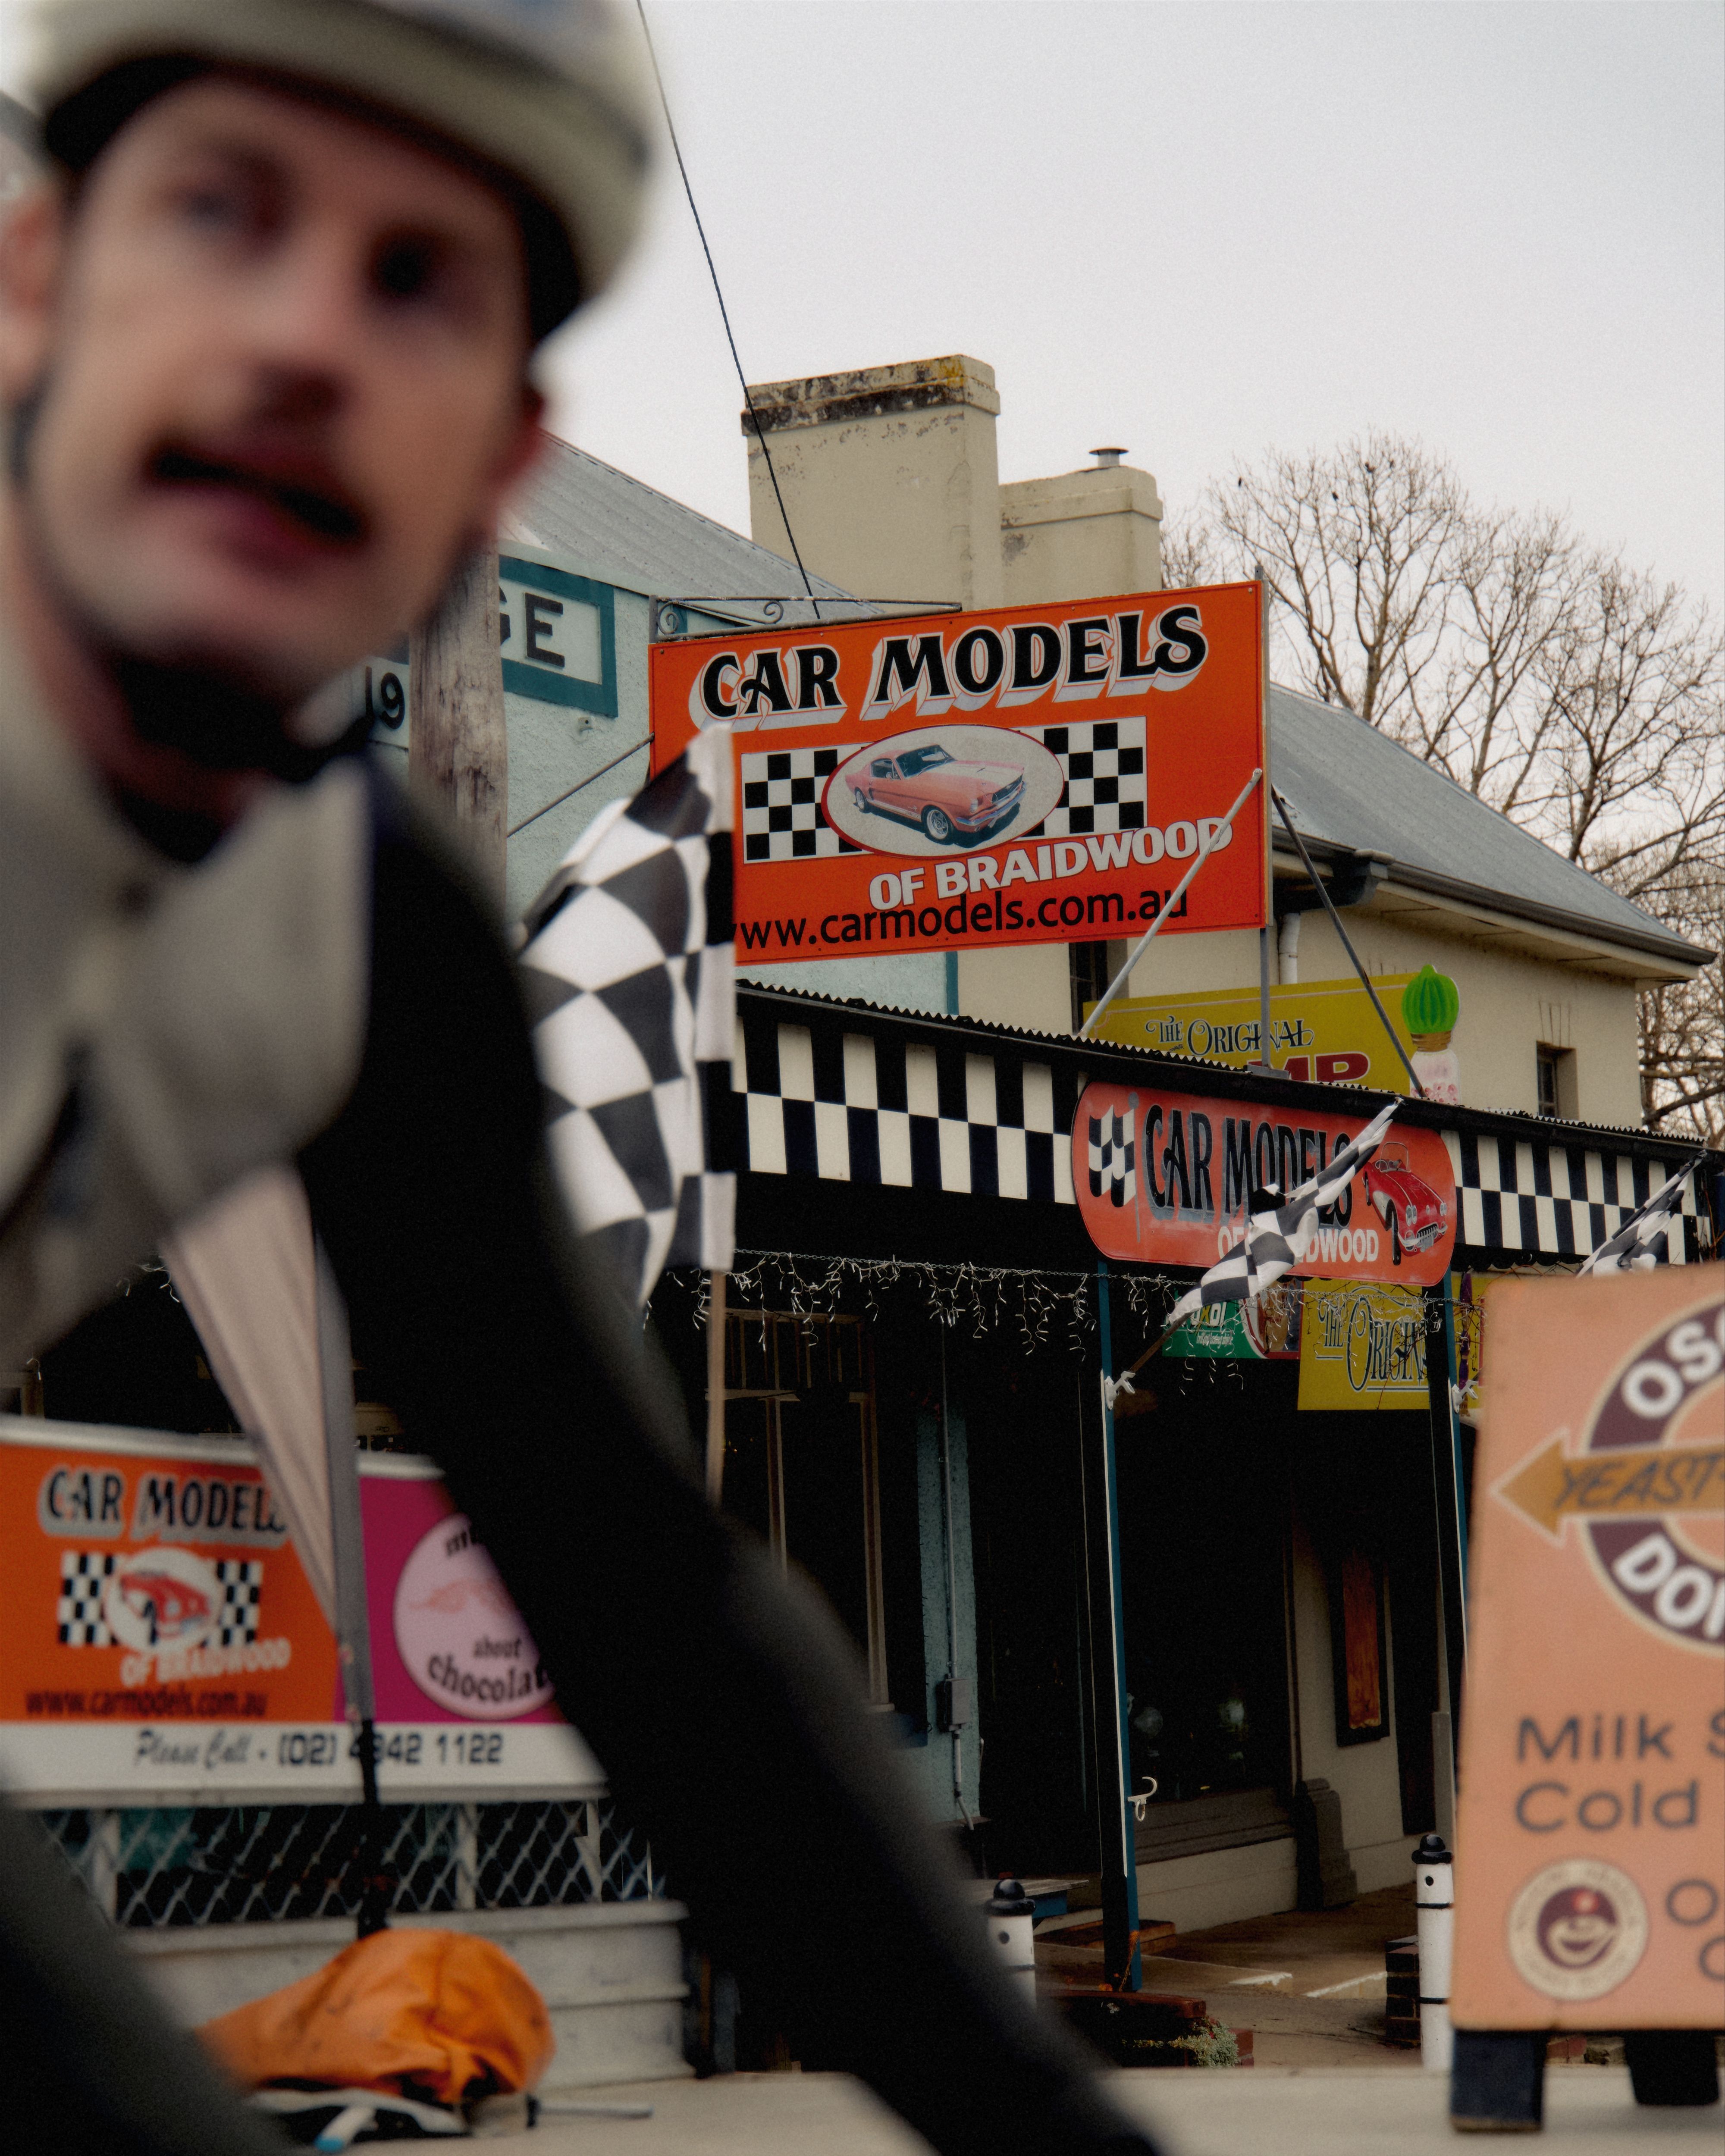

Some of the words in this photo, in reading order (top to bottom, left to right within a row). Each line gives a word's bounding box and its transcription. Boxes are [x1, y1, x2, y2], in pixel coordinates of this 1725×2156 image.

[695, 645, 846, 724] CAR
[862, 605, 1208, 714] MODELS
[869, 867, 925, 910] OF
[935, 817, 1233, 899] BRAIDWOOD
[733, 889, 1188, 949] ww.carmodels.com.au
[1145, 1015, 1184, 1043] THE
[1187, 1019, 1314, 1056] ORIGINAL
[1143, 1104, 1217, 1219] CAR
[1221, 1115, 1352, 1228] MODELS
[1304, 1228, 1379, 1263] DWOOD
[1318, 1299, 1346, 1347] THE
[1347, 1295, 1428, 1391] ORIGIN
[1620, 1307, 1725, 1420] OS
[45, 1467, 124, 1529] CAR
[437, 1733, 503, 1764] 1122
[1517, 1715, 1674, 1761] Milk
[1515, 1779, 1699, 1833] Cold
